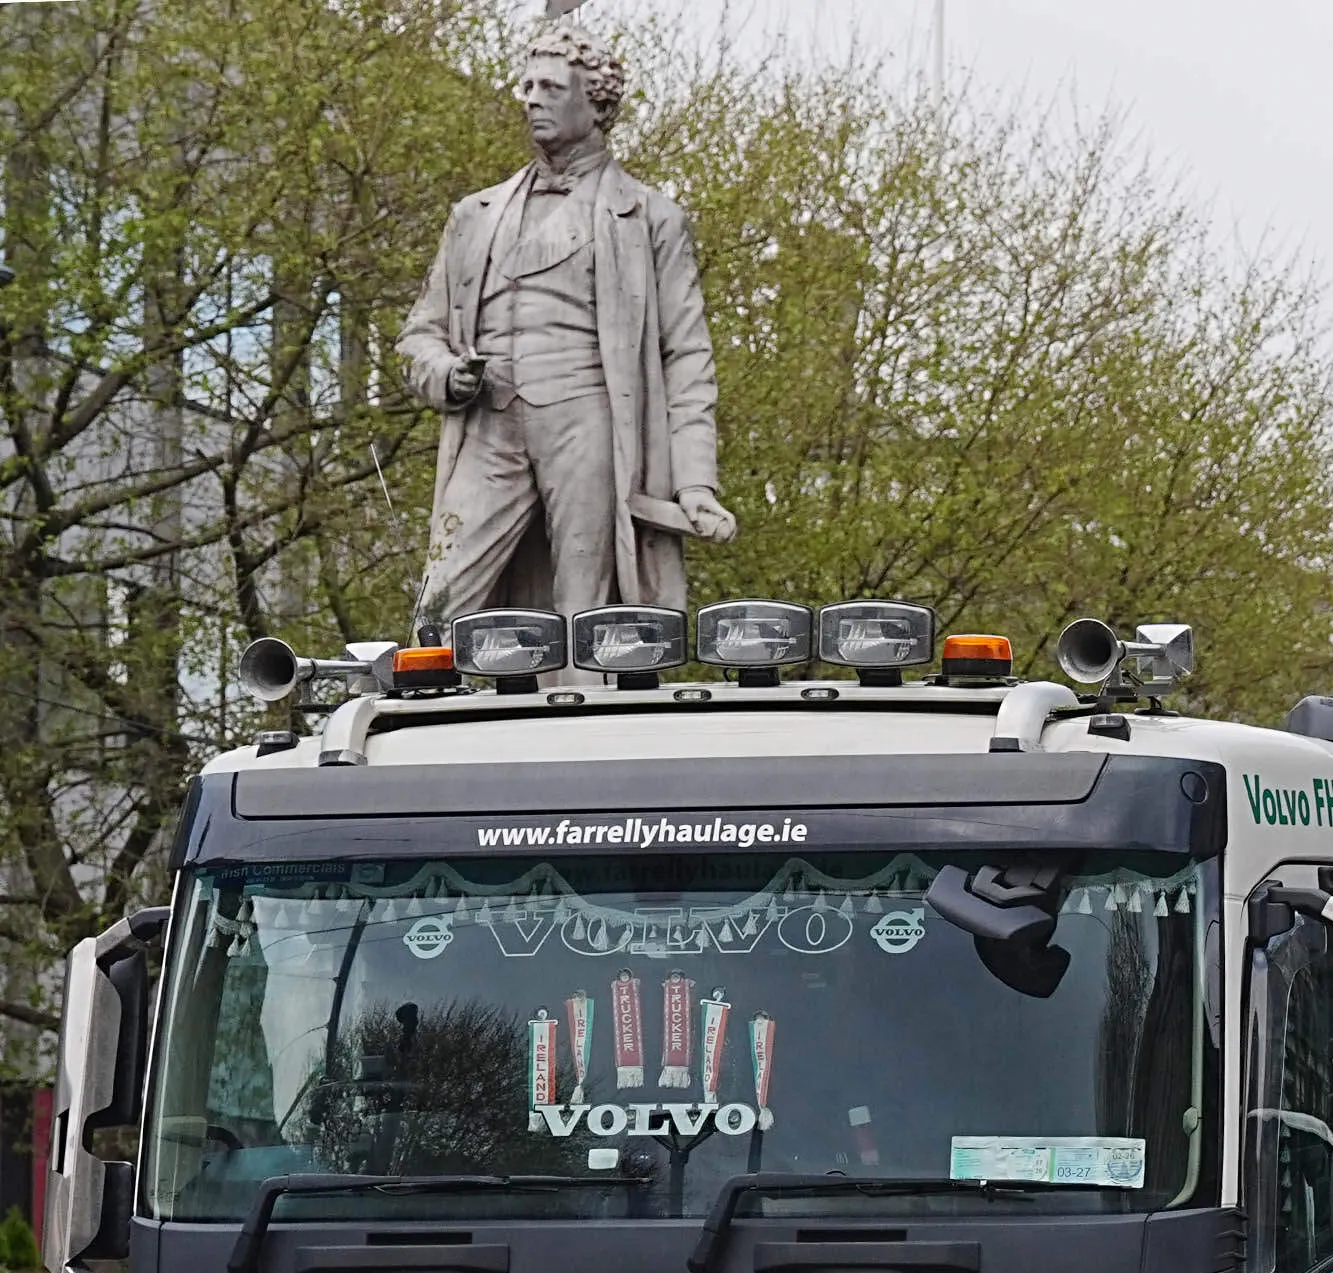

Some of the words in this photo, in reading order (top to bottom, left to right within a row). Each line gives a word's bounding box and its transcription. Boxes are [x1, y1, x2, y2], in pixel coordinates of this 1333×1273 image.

[478, 818, 808, 849] www.farrellyhaulage.ie
[404, 932, 454, 944] VOLVO
[475, 905, 853, 957] VOLVO
[872, 926, 923, 938] VOLVO
[576, 1007, 586, 1079] IRELAND
[619, 985, 634, 1052] TRUCKER
[671, 986, 684, 1052] TRUCKER
[535, 1034, 546, 1103] IRELAND
[704, 1016, 717, 1083] IRELAND
[539, 1103, 756, 1137] VOLVO
[1057, 1166, 1091, 1178] 03-27
